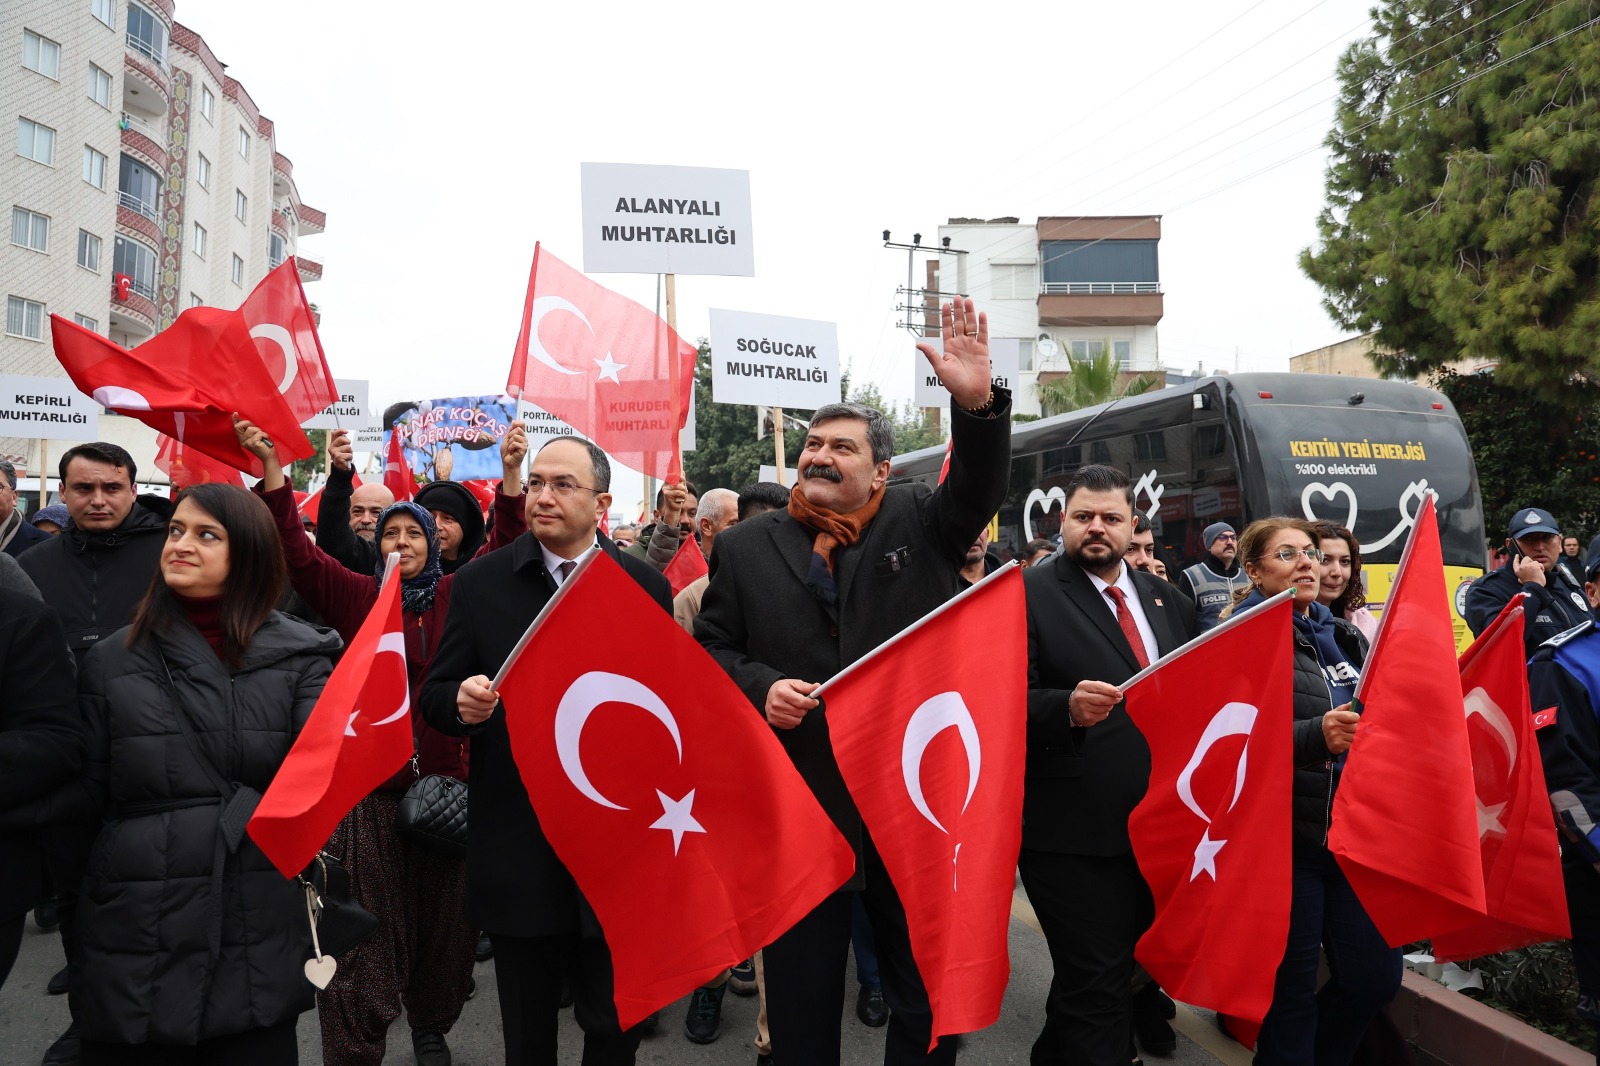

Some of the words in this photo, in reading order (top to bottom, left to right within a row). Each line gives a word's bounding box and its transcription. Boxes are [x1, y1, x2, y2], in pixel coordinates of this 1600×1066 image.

[615, 197, 720, 216] ALANYALI
[602, 225, 736, 245] MUHTARLIĞI
[736, 337, 817, 359] SOĞUCAK
[726, 361, 828, 384] MUHTARLIĞI
[15, 394, 71, 407] KEPİRLİ
[610, 400, 672, 413] KURUDER
[0, 409, 87, 424] MUHTARLIĞI
[449, 407, 508, 439] KOÇAŞ
[605, 418, 670, 432] MUHTARLI
[524, 425, 573, 435] UHTARLIĞI
[1289, 437, 1340, 458] KENTİN
[1340, 438, 1372, 459] YENİ
[1371, 440, 1426, 461] ENERJİSİ
[1295, 463, 1325, 475] %100
[1327, 463, 1378, 475] elektrikli
